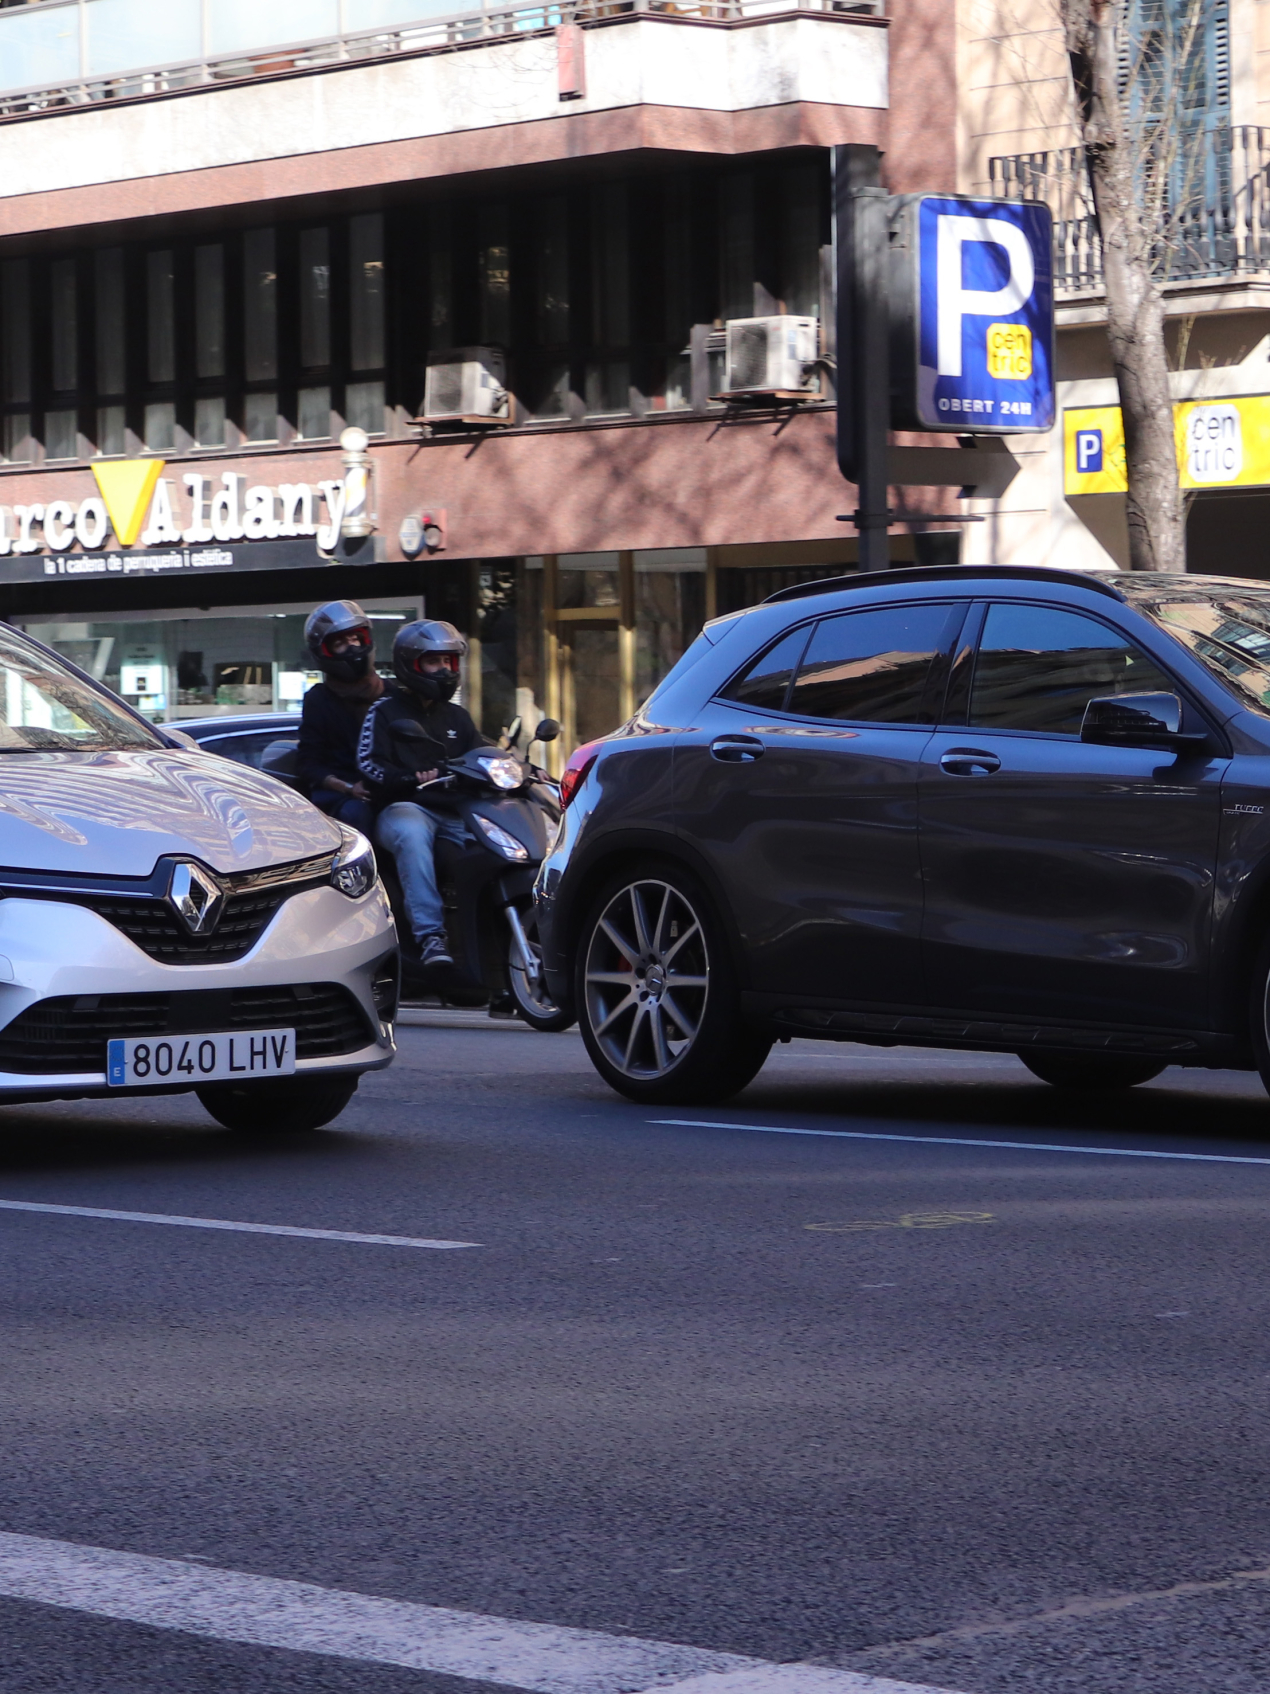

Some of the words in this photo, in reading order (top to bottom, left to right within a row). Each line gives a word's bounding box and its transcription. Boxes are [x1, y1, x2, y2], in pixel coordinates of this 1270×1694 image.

[936, 213, 1035, 377] P
[990, 331, 1027, 351] cen
[991, 351, 1029, 373] tric
[937, 397, 995, 414] OBERT
[999, 400, 1032, 416] 24H
[1193, 415, 1235, 441] cen
[1079, 434, 1100, 470] P
[1192, 442, 1235, 472] tric
[141, 471, 347, 551] Aldany
[44, 558, 57, 575] la
[66, 555, 106, 574] cadena
[107, 554, 123, 571] de
[133, 1039, 216, 1078] 8040
[229, 1034, 288, 1072] LHV
[113, 1066, 121, 1077] E
